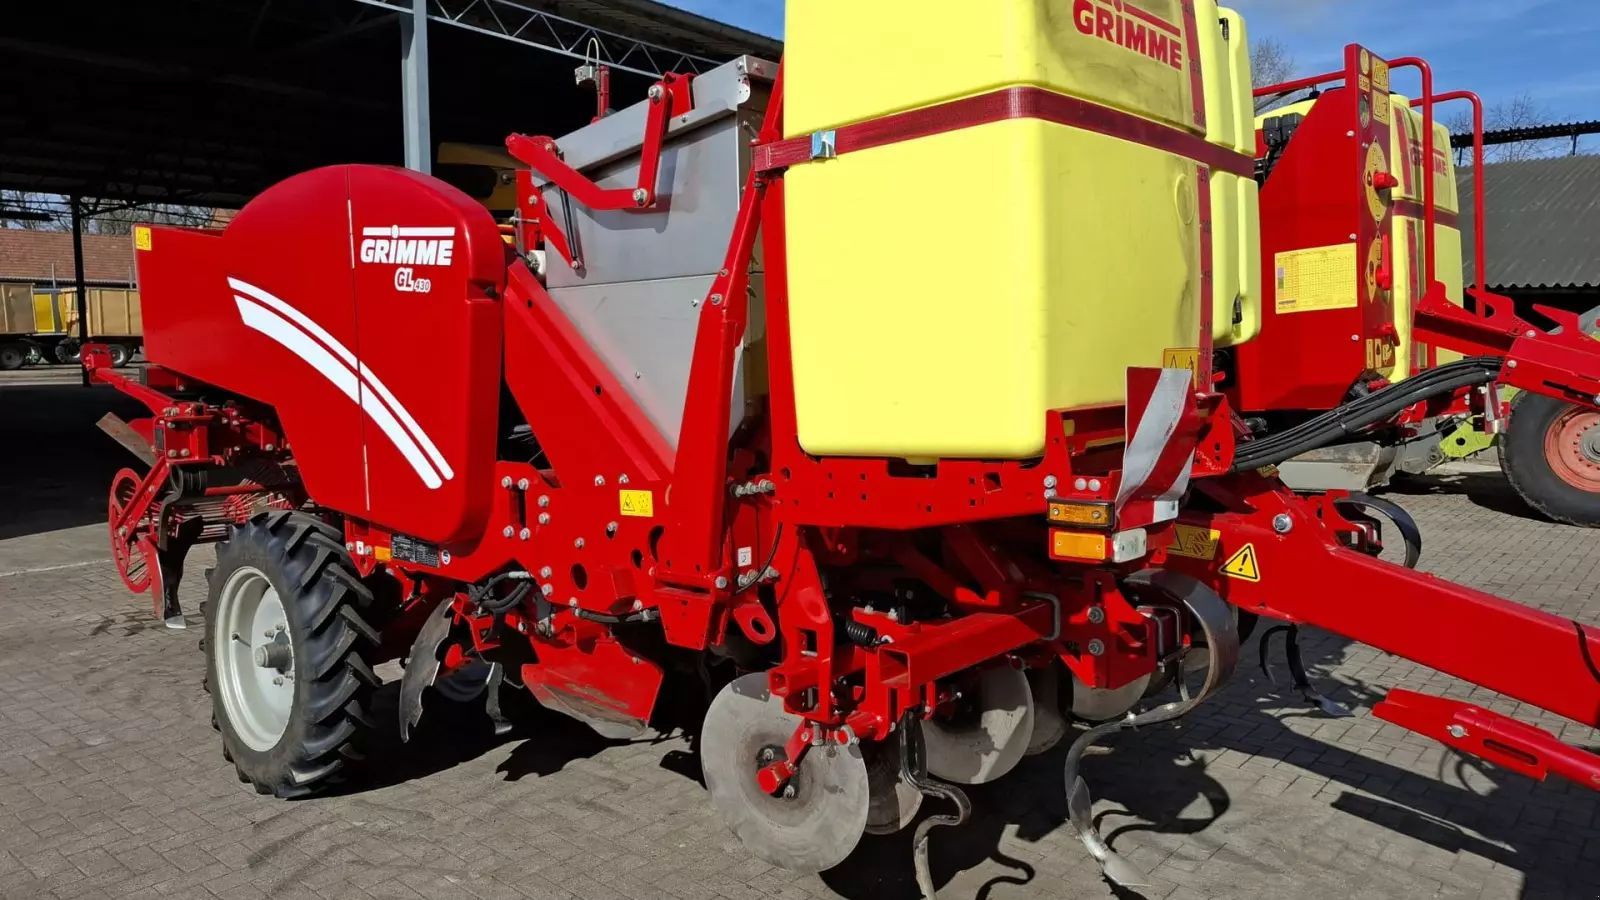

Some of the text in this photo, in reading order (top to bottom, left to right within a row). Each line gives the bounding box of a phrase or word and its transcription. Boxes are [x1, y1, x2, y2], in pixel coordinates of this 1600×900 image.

[1073, 0, 1182, 71] GRIMME
[360, 225, 454, 266] GRIMME
[395, 268, 431, 292] GL 430
